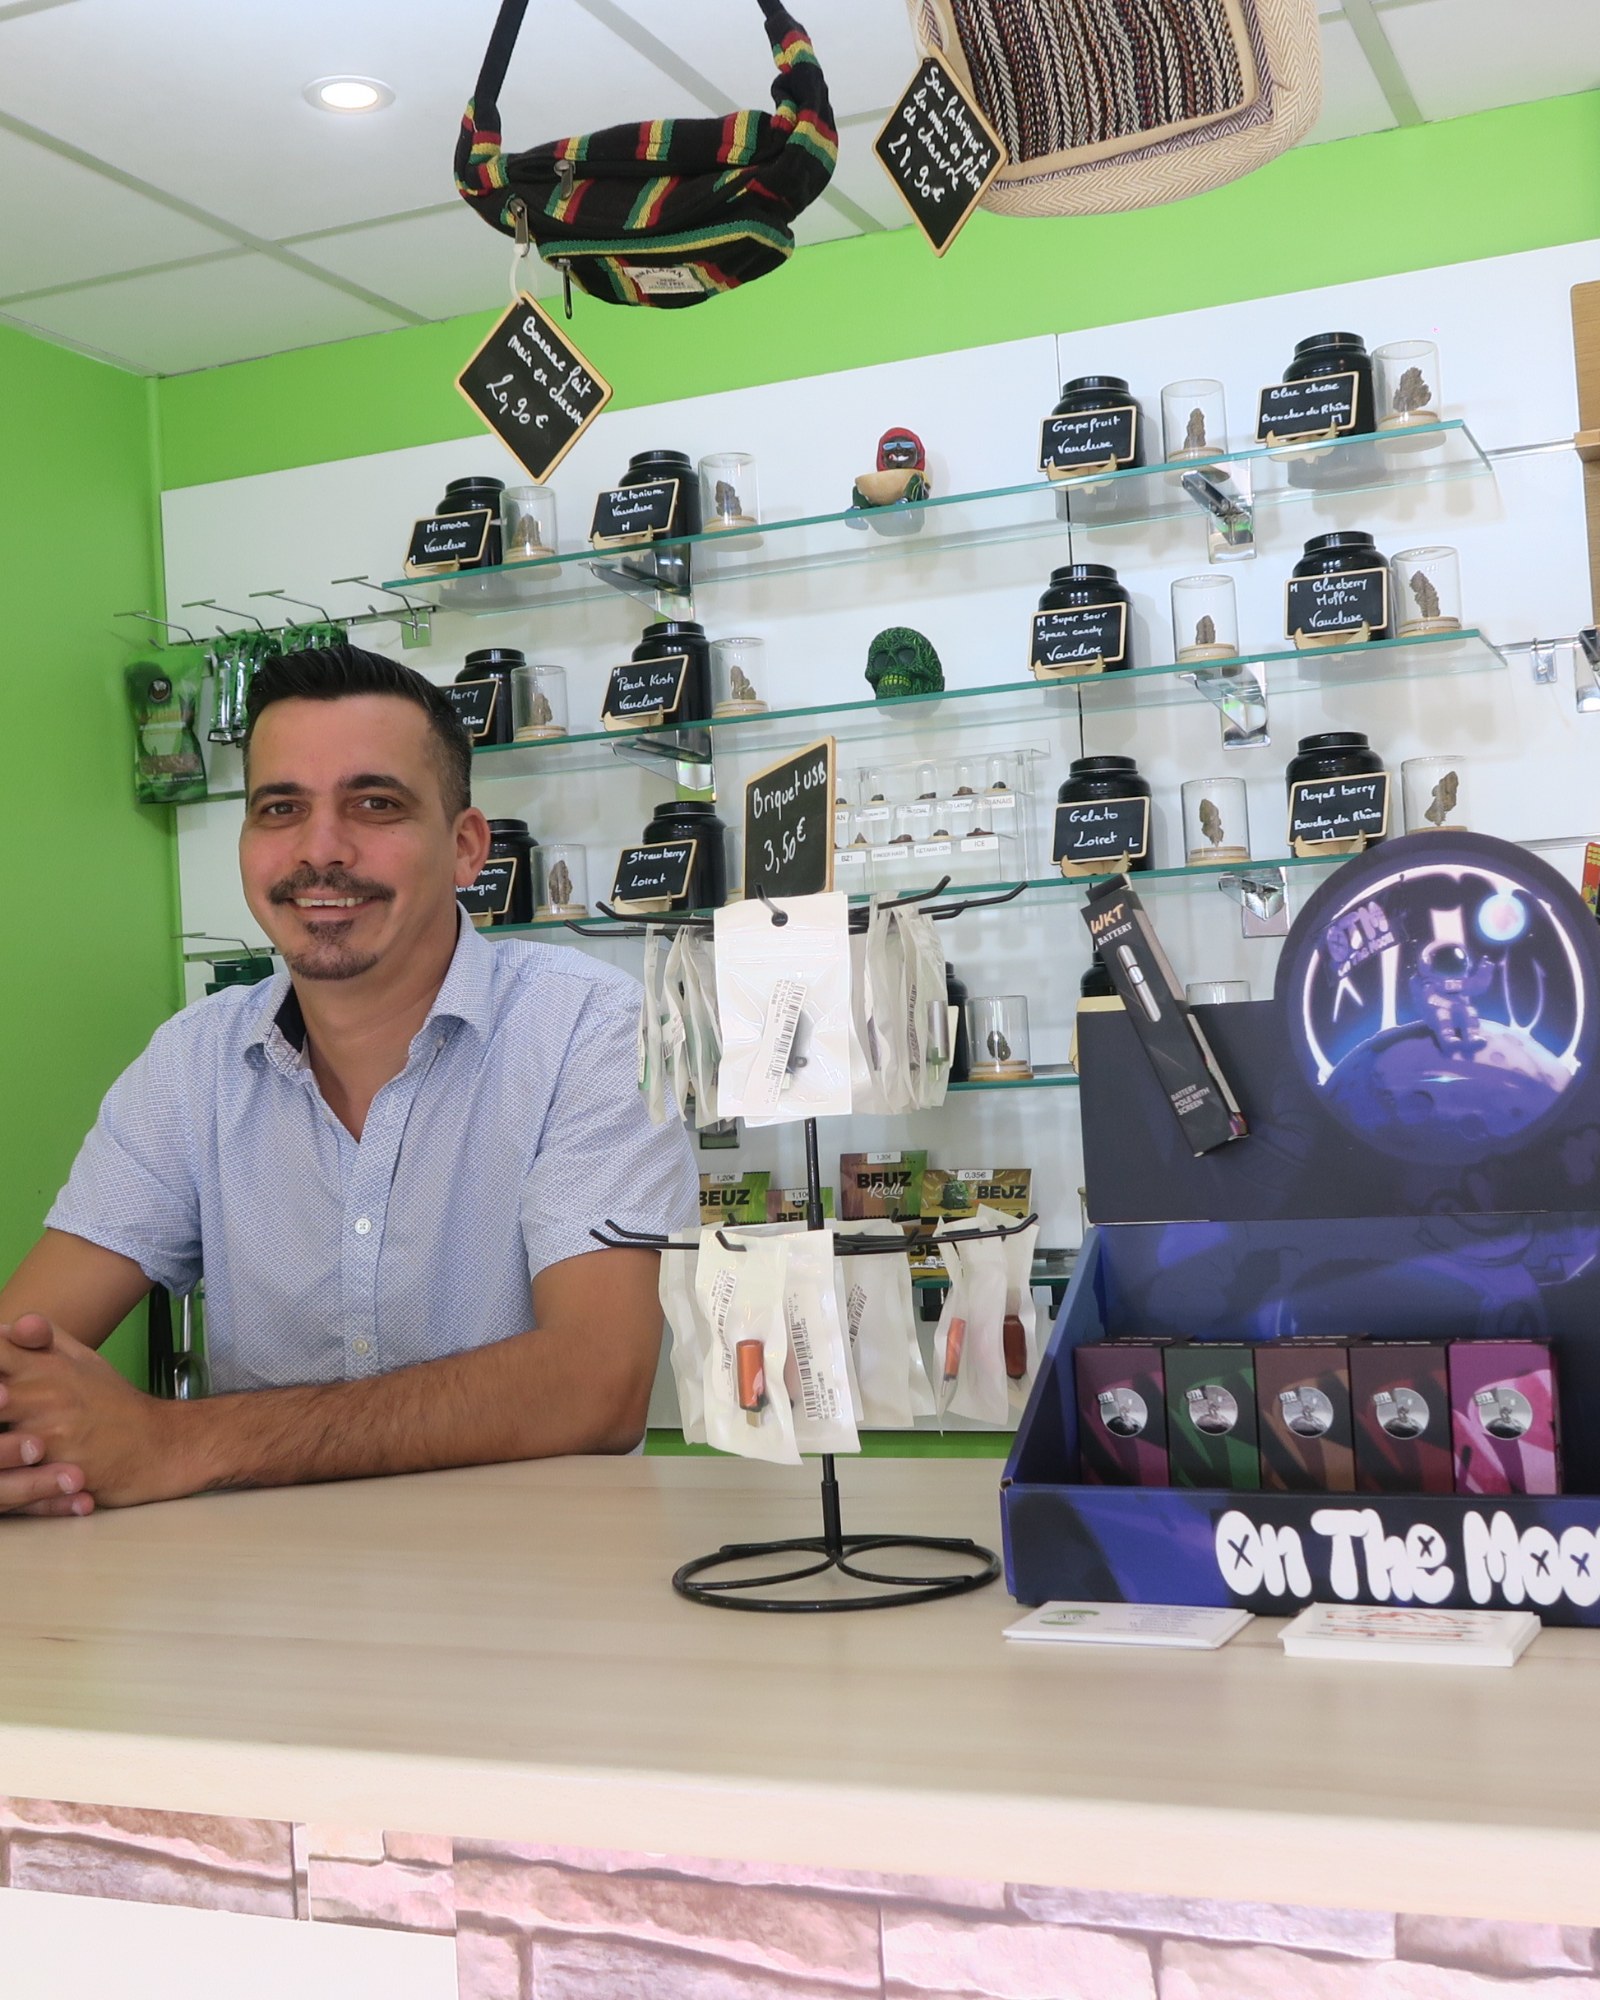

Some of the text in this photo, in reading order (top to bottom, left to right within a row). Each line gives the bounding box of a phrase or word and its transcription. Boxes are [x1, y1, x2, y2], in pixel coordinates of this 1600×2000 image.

[902, 105, 917, 126] de
[913, 87, 928, 111] la
[928, 109, 948, 143] main
[949, 142, 961, 161] en
[924, 66, 945, 101] Sac
[979, 149, 991, 169] à
[533, 367, 548, 386] en
[561, 365, 592, 398] fait
[1270, 386, 1300, 399] Blue
[1051, 415, 1121, 434] Grapefruit
[1057, 437, 1114, 455] Vaucluse
[609, 488, 665, 503] Plutonium
[426, 520, 471, 534] Mimosa
[423, 537, 467, 553] Vaucluse
[1312, 577, 1368, 592] Blueberry
[1051, 614, 1079, 626] Super
[1082, 612, 1108, 621] Sour
[1308, 610, 1364, 628] Vaucluse
[1046, 643, 1102, 661] Vaucluse
[616, 672, 674, 691] Peach Kush
[619, 693, 665, 710] Vaucluse
[752, 759, 828, 821] Briquet USB
[1300, 784, 1376, 804] Royal berry
[1069, 806, 1119, 823] Gelato
[1333, 814, 1350, 825] du
[763, 815, 807, 875] 3,50€
[1073, 830, 1118, 848] Loiret
[626, 847, 687, 865] Strawberry
[630, 872, 667, 887] Loiret
[1090, 903, 1124, 935] WKT
[1097, 921, 1133, 946] BATTERY
[1170, 1084, 1197, 1101] BATTERY
[1174, 1086, 1210, 1109] POLE WITH
[1178, 1098, 1204, 1116] SCREEN
[857, 1171, 912, 1189] BEUZ
[964, 1171, 987, 1179] 0,35€
[699, 1188, 750, 1207] BEUZ
[866, 1181, 905, 1199] Rolls
[977, 1185, 1027, 1199] BEUZ
[1215, 1508, 1600, 1607] On The Moo
